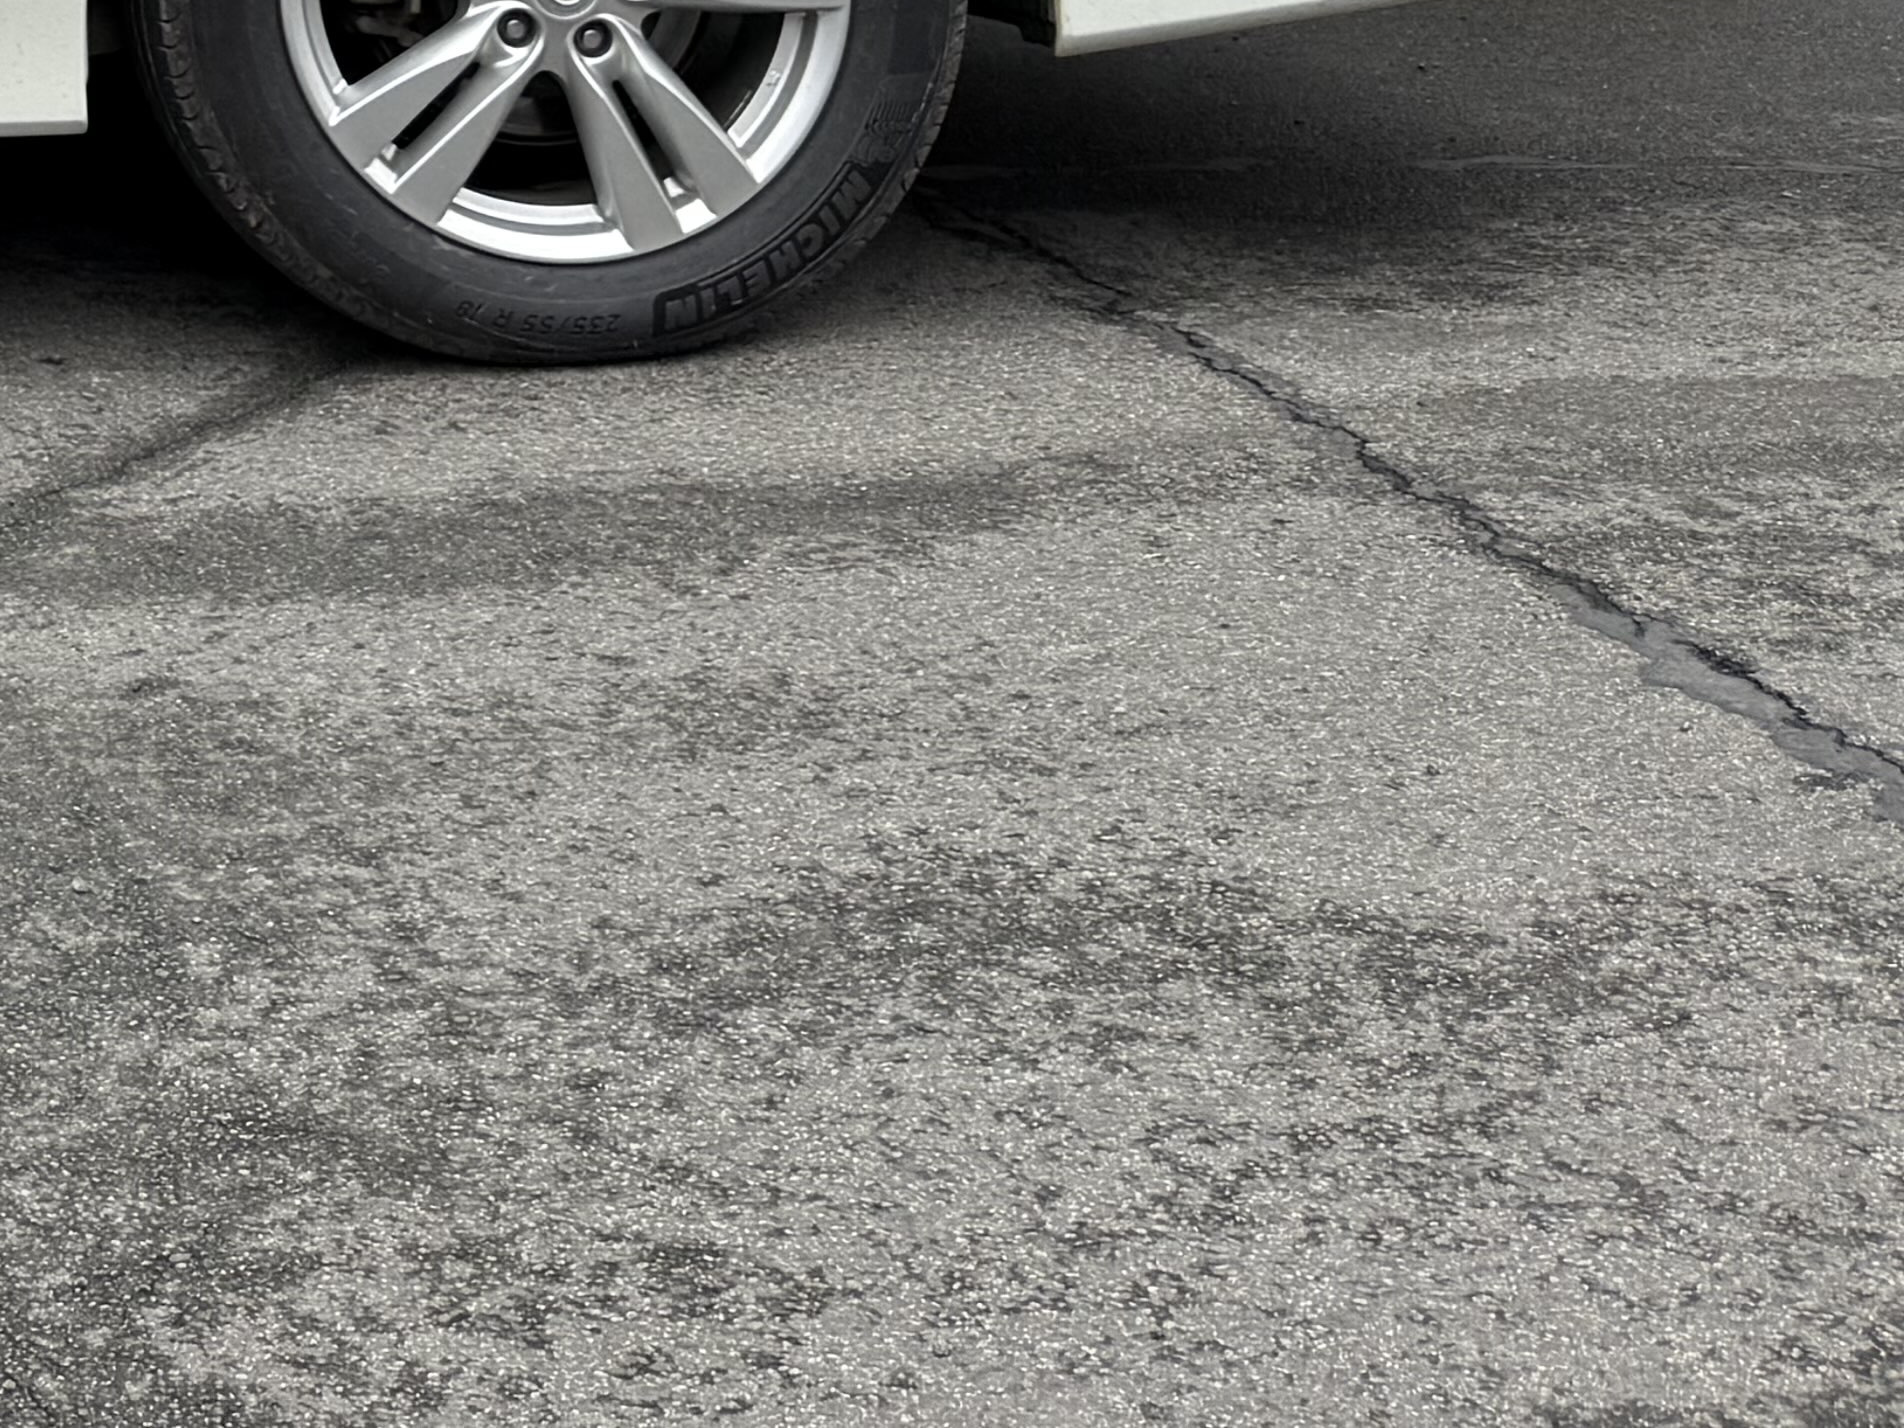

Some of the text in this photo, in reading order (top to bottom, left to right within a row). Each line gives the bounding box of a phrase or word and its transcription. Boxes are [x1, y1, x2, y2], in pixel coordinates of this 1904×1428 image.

[662, 170, 870, 332] MICHELIN
[493, 306, 515, 325] R
[520, 312, 621, 336] 235/55
